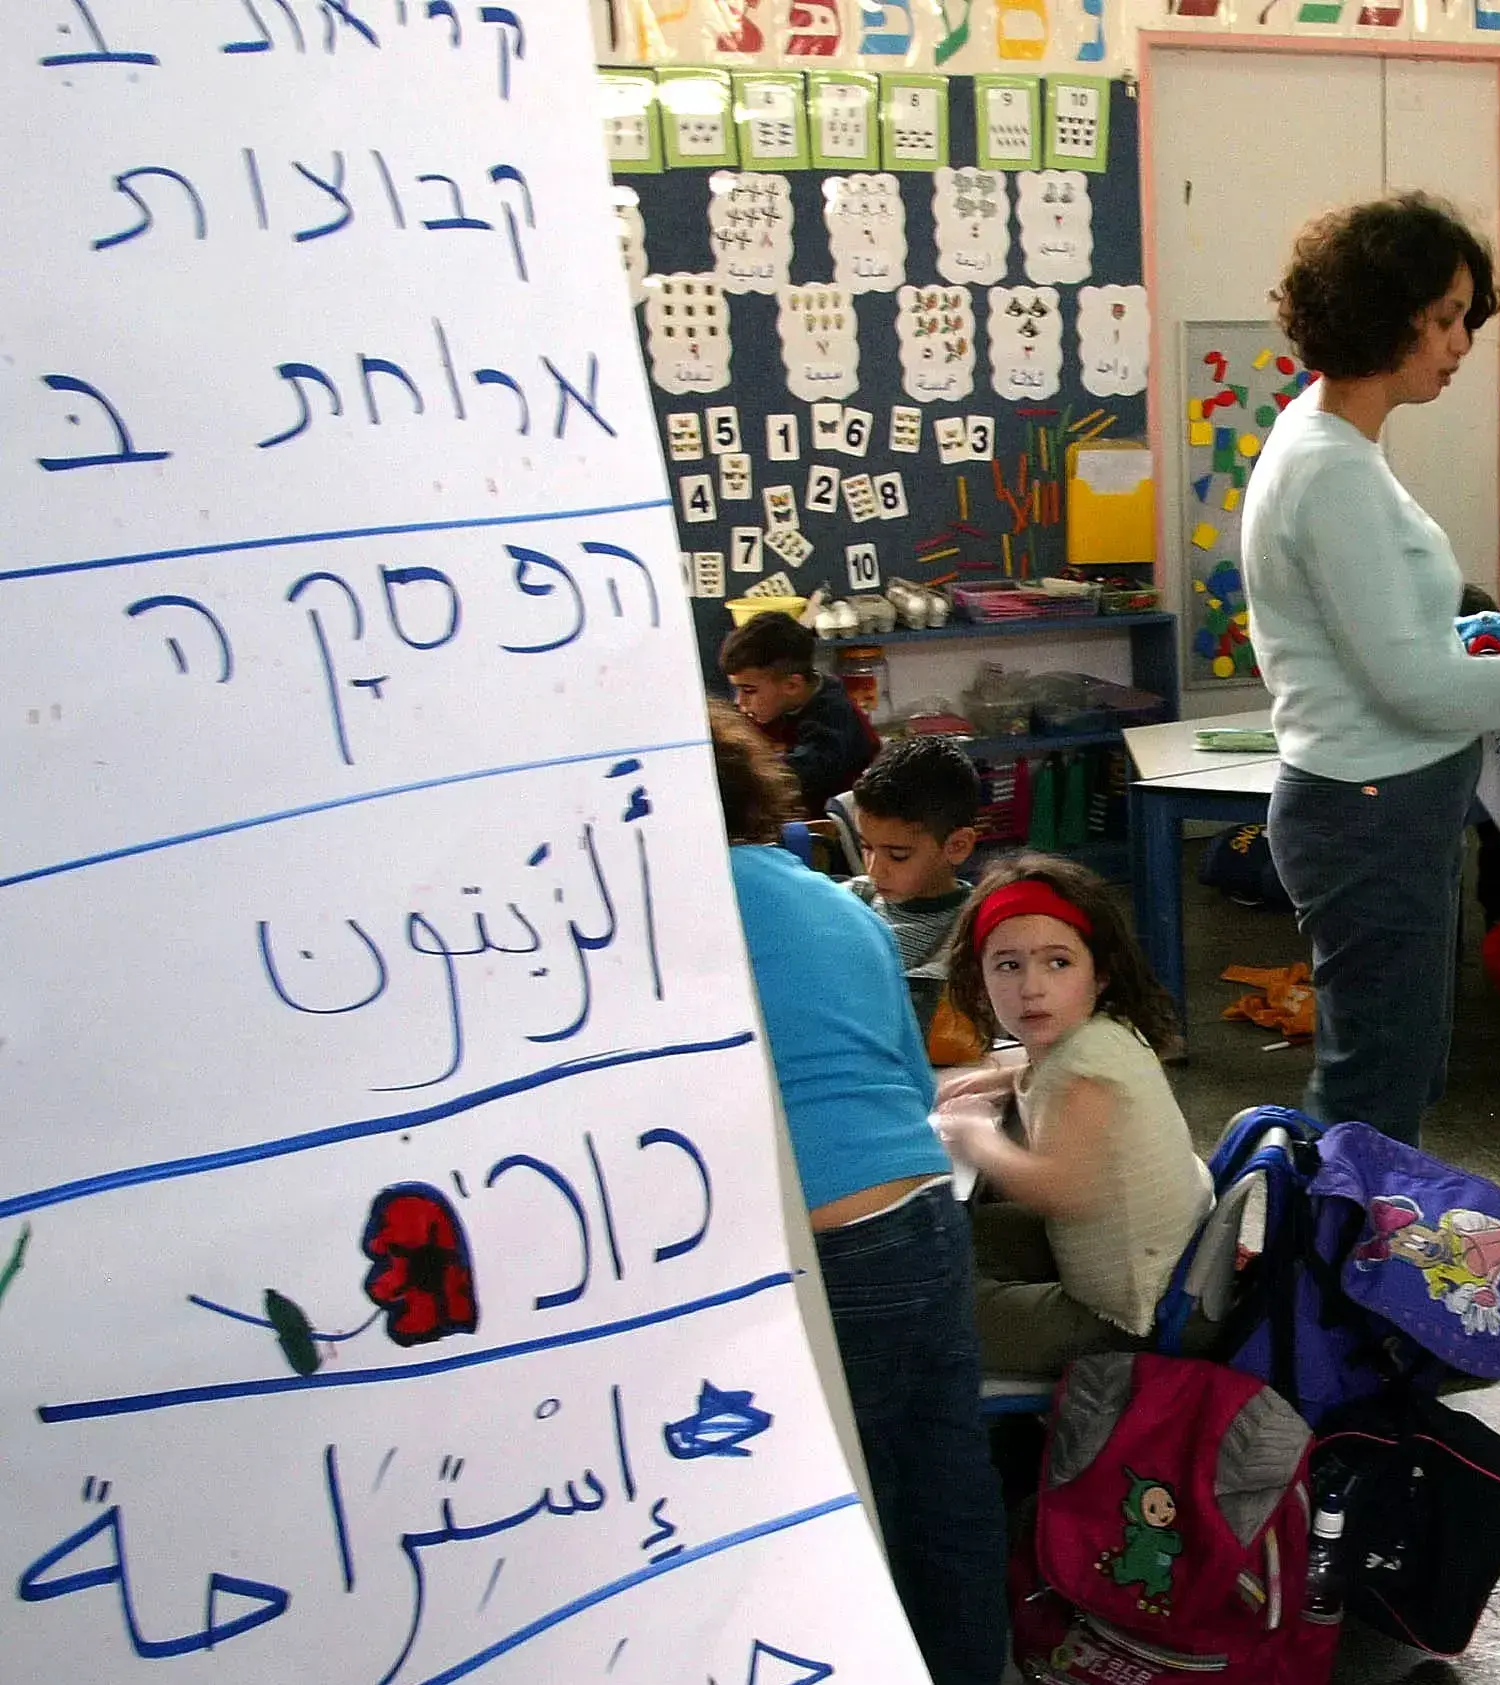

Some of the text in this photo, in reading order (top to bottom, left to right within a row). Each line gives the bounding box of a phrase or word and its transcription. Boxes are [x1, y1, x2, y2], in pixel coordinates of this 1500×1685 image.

[92, 146, 537, 284] קבוצות
[257, 315, 618, 449] ארוחת
[717, 416, 733, 447] 5
[778, 424, 790, 453] 1
[845, 418, 863, 447] 6
[972, 424, 988, 454] 3
[690, 484, 710, 514] 4
[815, 475, 833, 505] 2
[880, 480, 898, 510] 8
[740, 534, 757, 565] 7
[852, 552, 873, 581] 10
